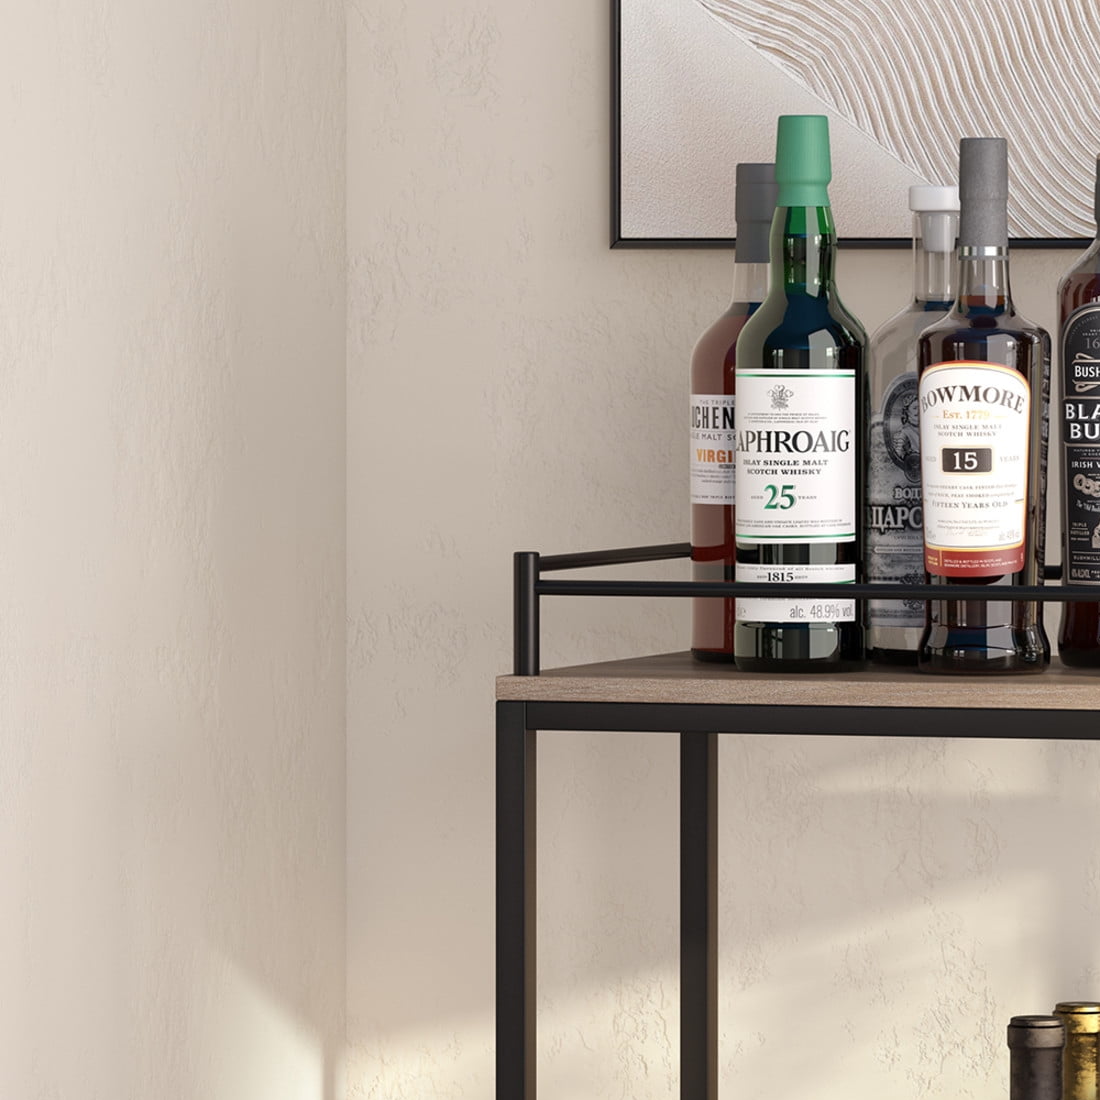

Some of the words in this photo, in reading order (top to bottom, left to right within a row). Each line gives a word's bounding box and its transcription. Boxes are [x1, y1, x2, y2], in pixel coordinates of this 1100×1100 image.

[921, 385, 1025, 414] BOWMORE
[735, 429, 850, 454] APHROAIG
[953, 452, 978, 470] 15
[763, 484, 796, 510] 25
[894, 487, 922, 499] ВОД
[961, 501, 990, 509] YEARS
[872, 506, 922, 533] ЦАРС
[767, 572, 794, 582] 1815
[789, 605, 806, 619] alc.
[810, 604, 840, 619] 48.9%
